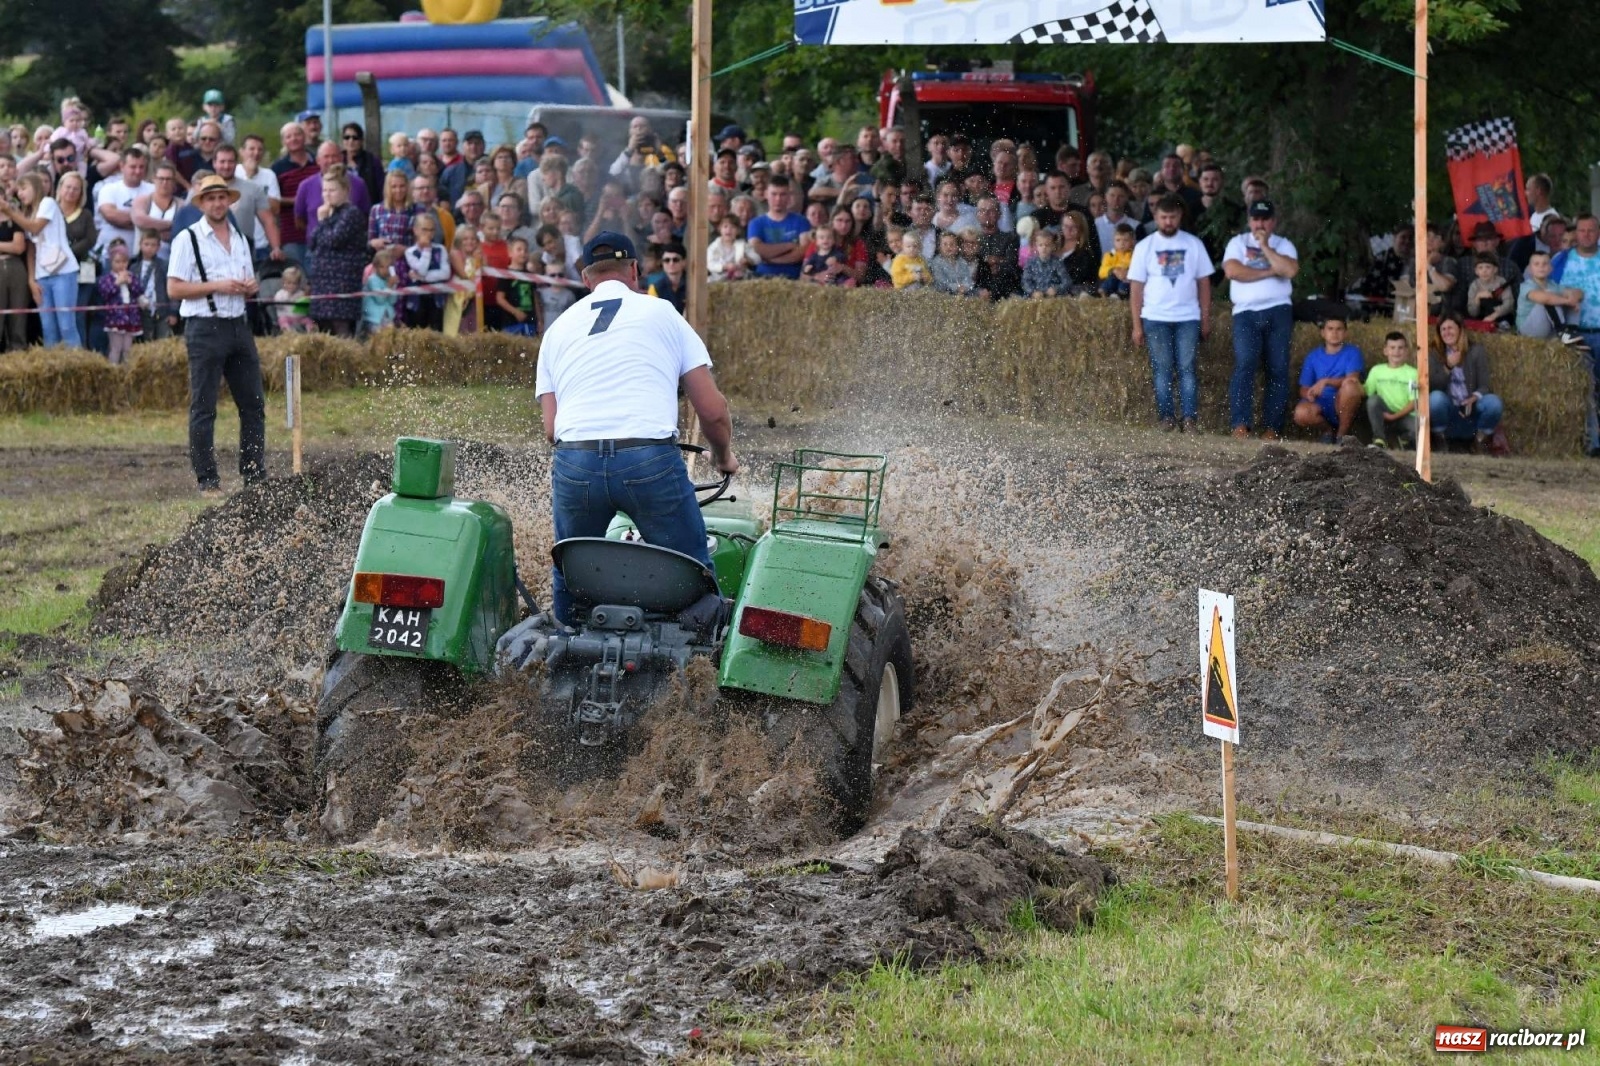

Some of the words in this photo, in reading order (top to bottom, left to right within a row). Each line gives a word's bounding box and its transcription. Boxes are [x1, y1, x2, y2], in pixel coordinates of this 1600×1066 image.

[587, 298, 623, 336] 7
[378, 606, 420, 627] KAH
[374, 627, 422, 648] 2042
